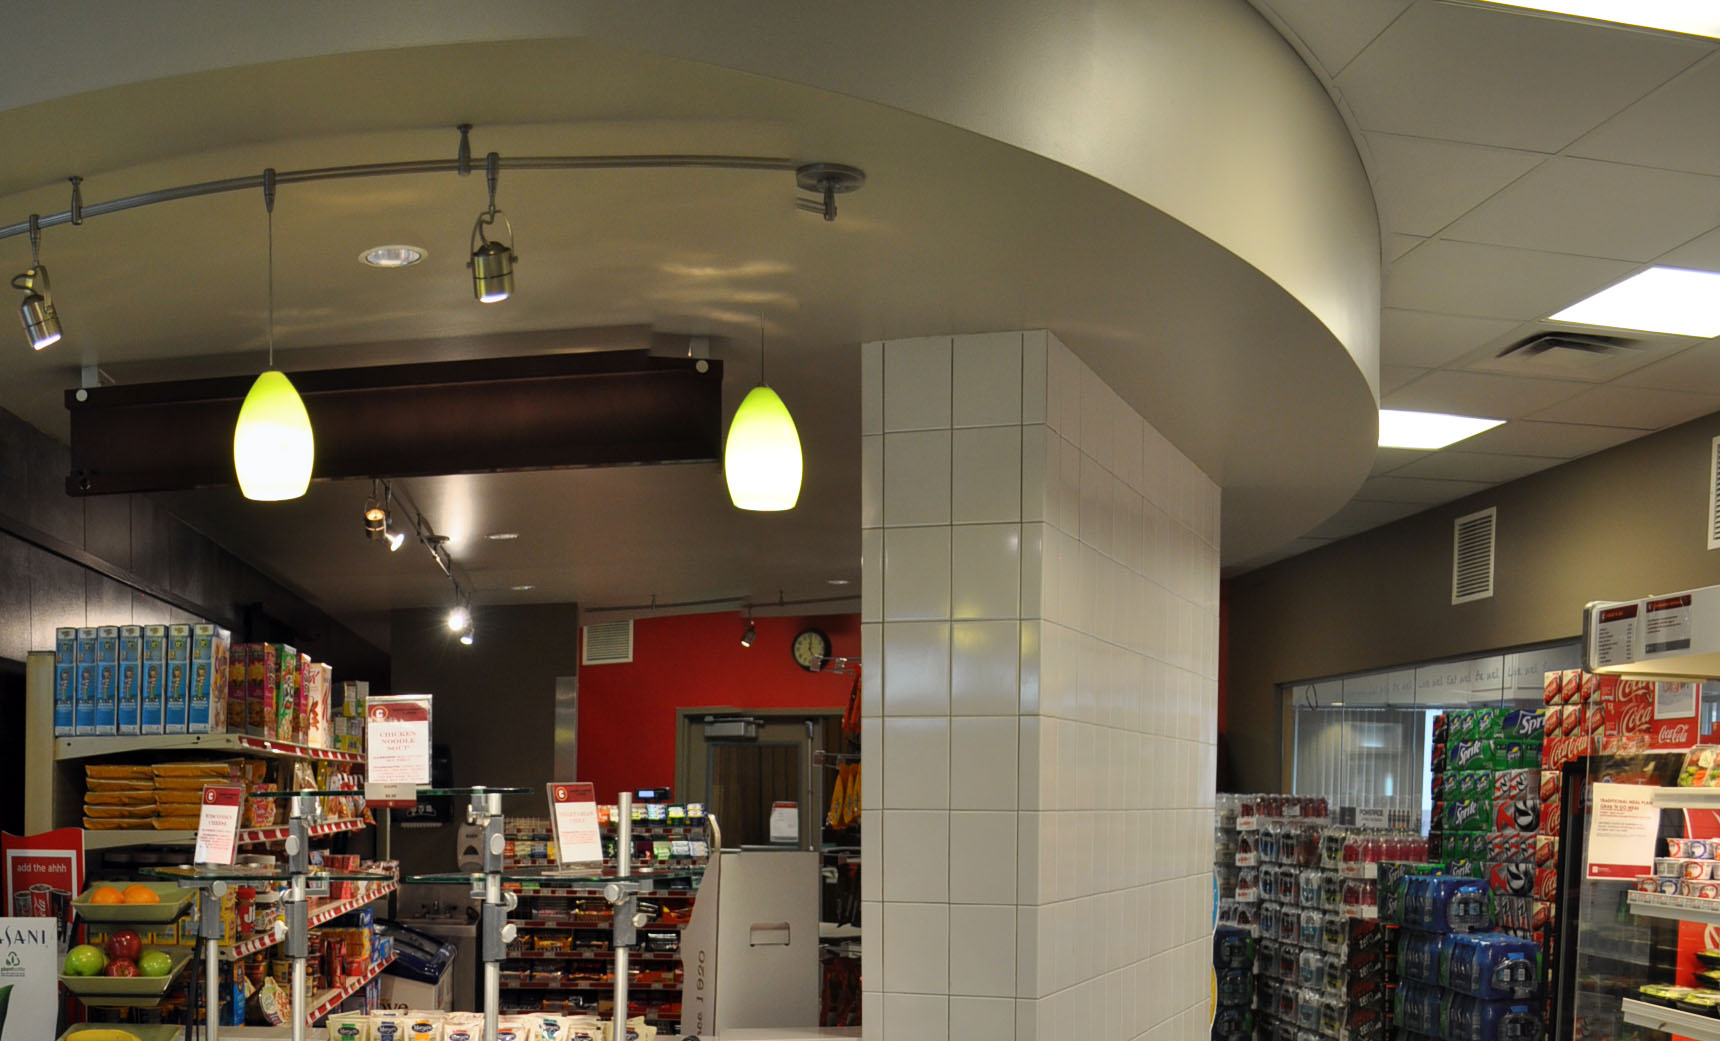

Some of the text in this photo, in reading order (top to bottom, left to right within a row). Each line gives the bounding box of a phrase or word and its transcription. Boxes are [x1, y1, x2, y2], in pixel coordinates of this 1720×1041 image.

[1658, 724, 1690, 744] Coca-Cola
[1458, 740, 1481, 766] Sprite
[1455, 800, 1477, 824] Sprite
[17, 863, 67, 873] add the ahhh
[696, 950, 705, 1004] 1920
